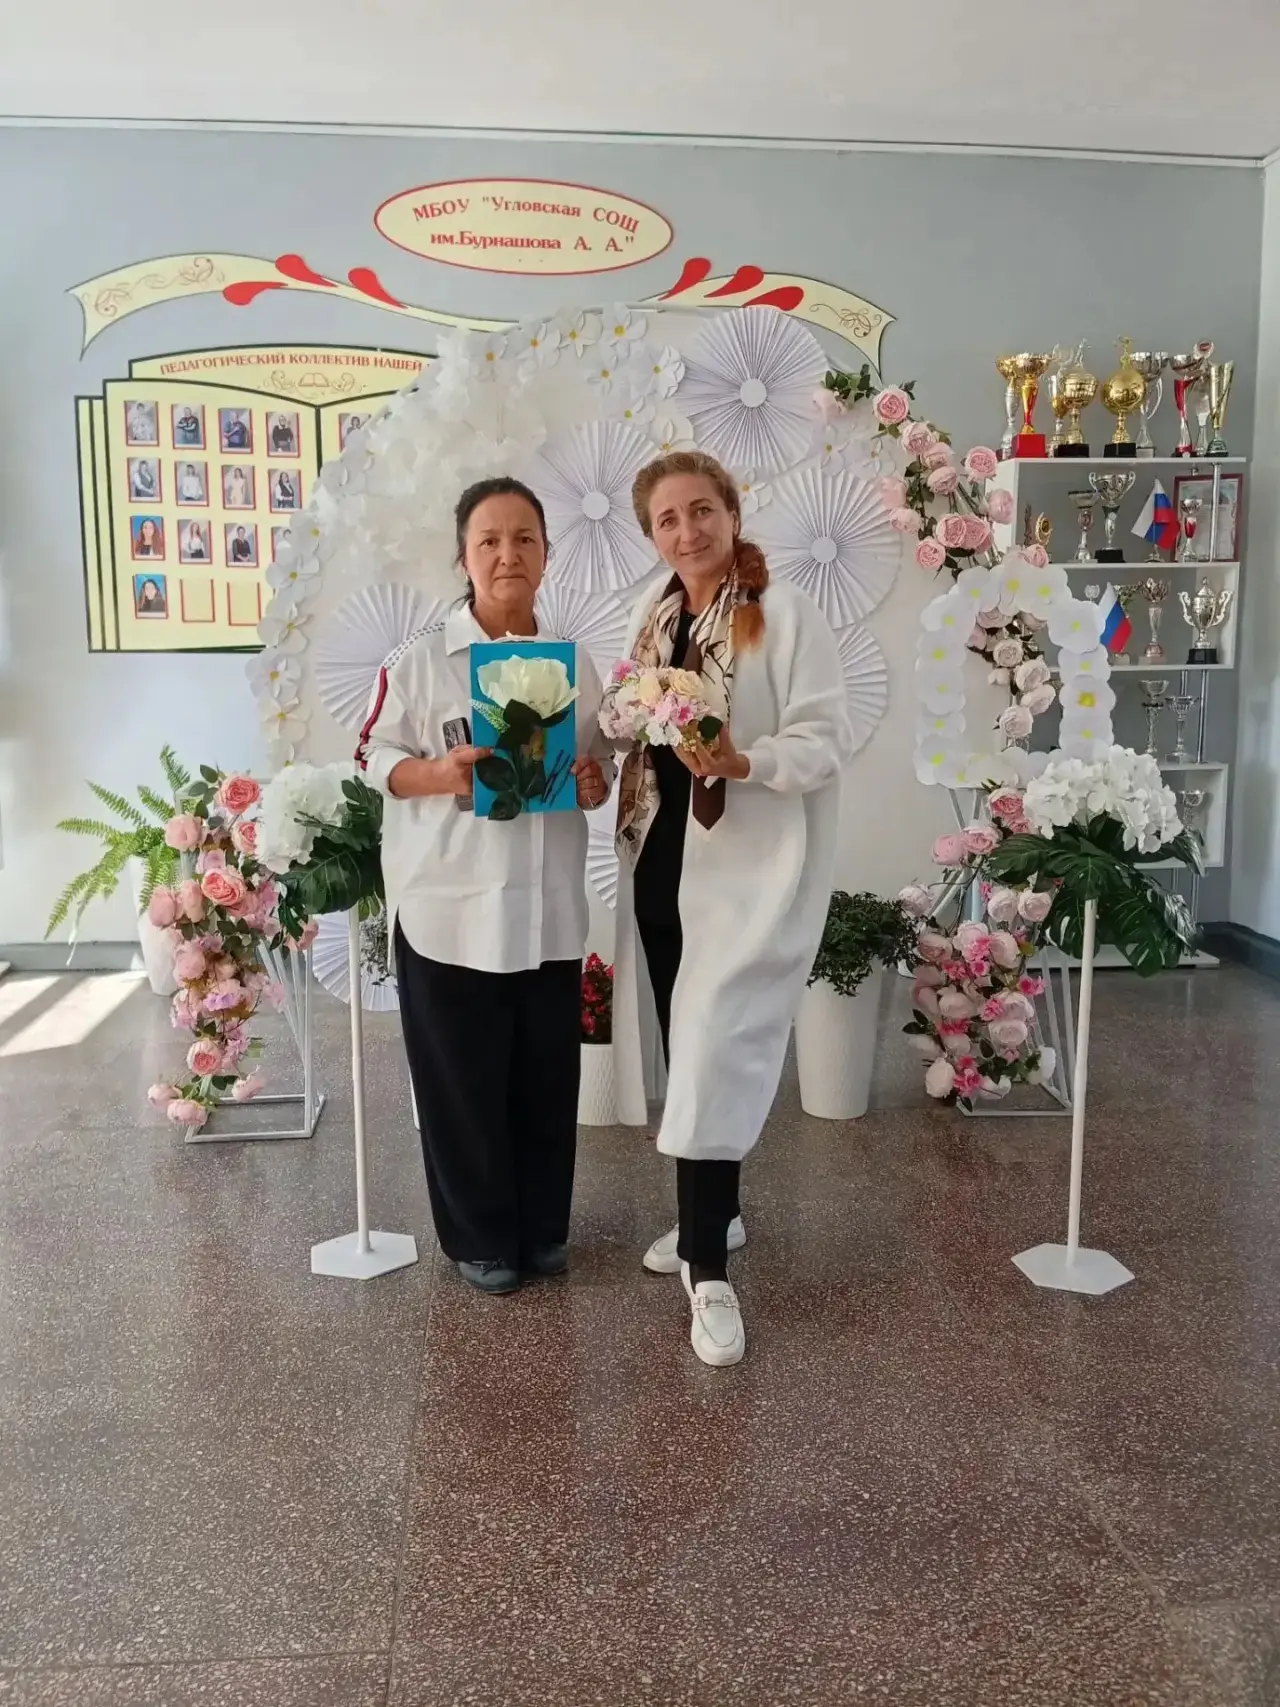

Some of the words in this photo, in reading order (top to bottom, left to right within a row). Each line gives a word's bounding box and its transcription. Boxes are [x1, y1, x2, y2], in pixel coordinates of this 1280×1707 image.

[412, 198, 470, 222] МБОУ
[592, 207, 640, 234] СОШ
[573, 236, 592, 251] А.
[160, 352, 287, 375] ПЕДАГОГИЧЕСКИЙ
[289, 353, 371, 367] КОЛЛЕКТИВ
